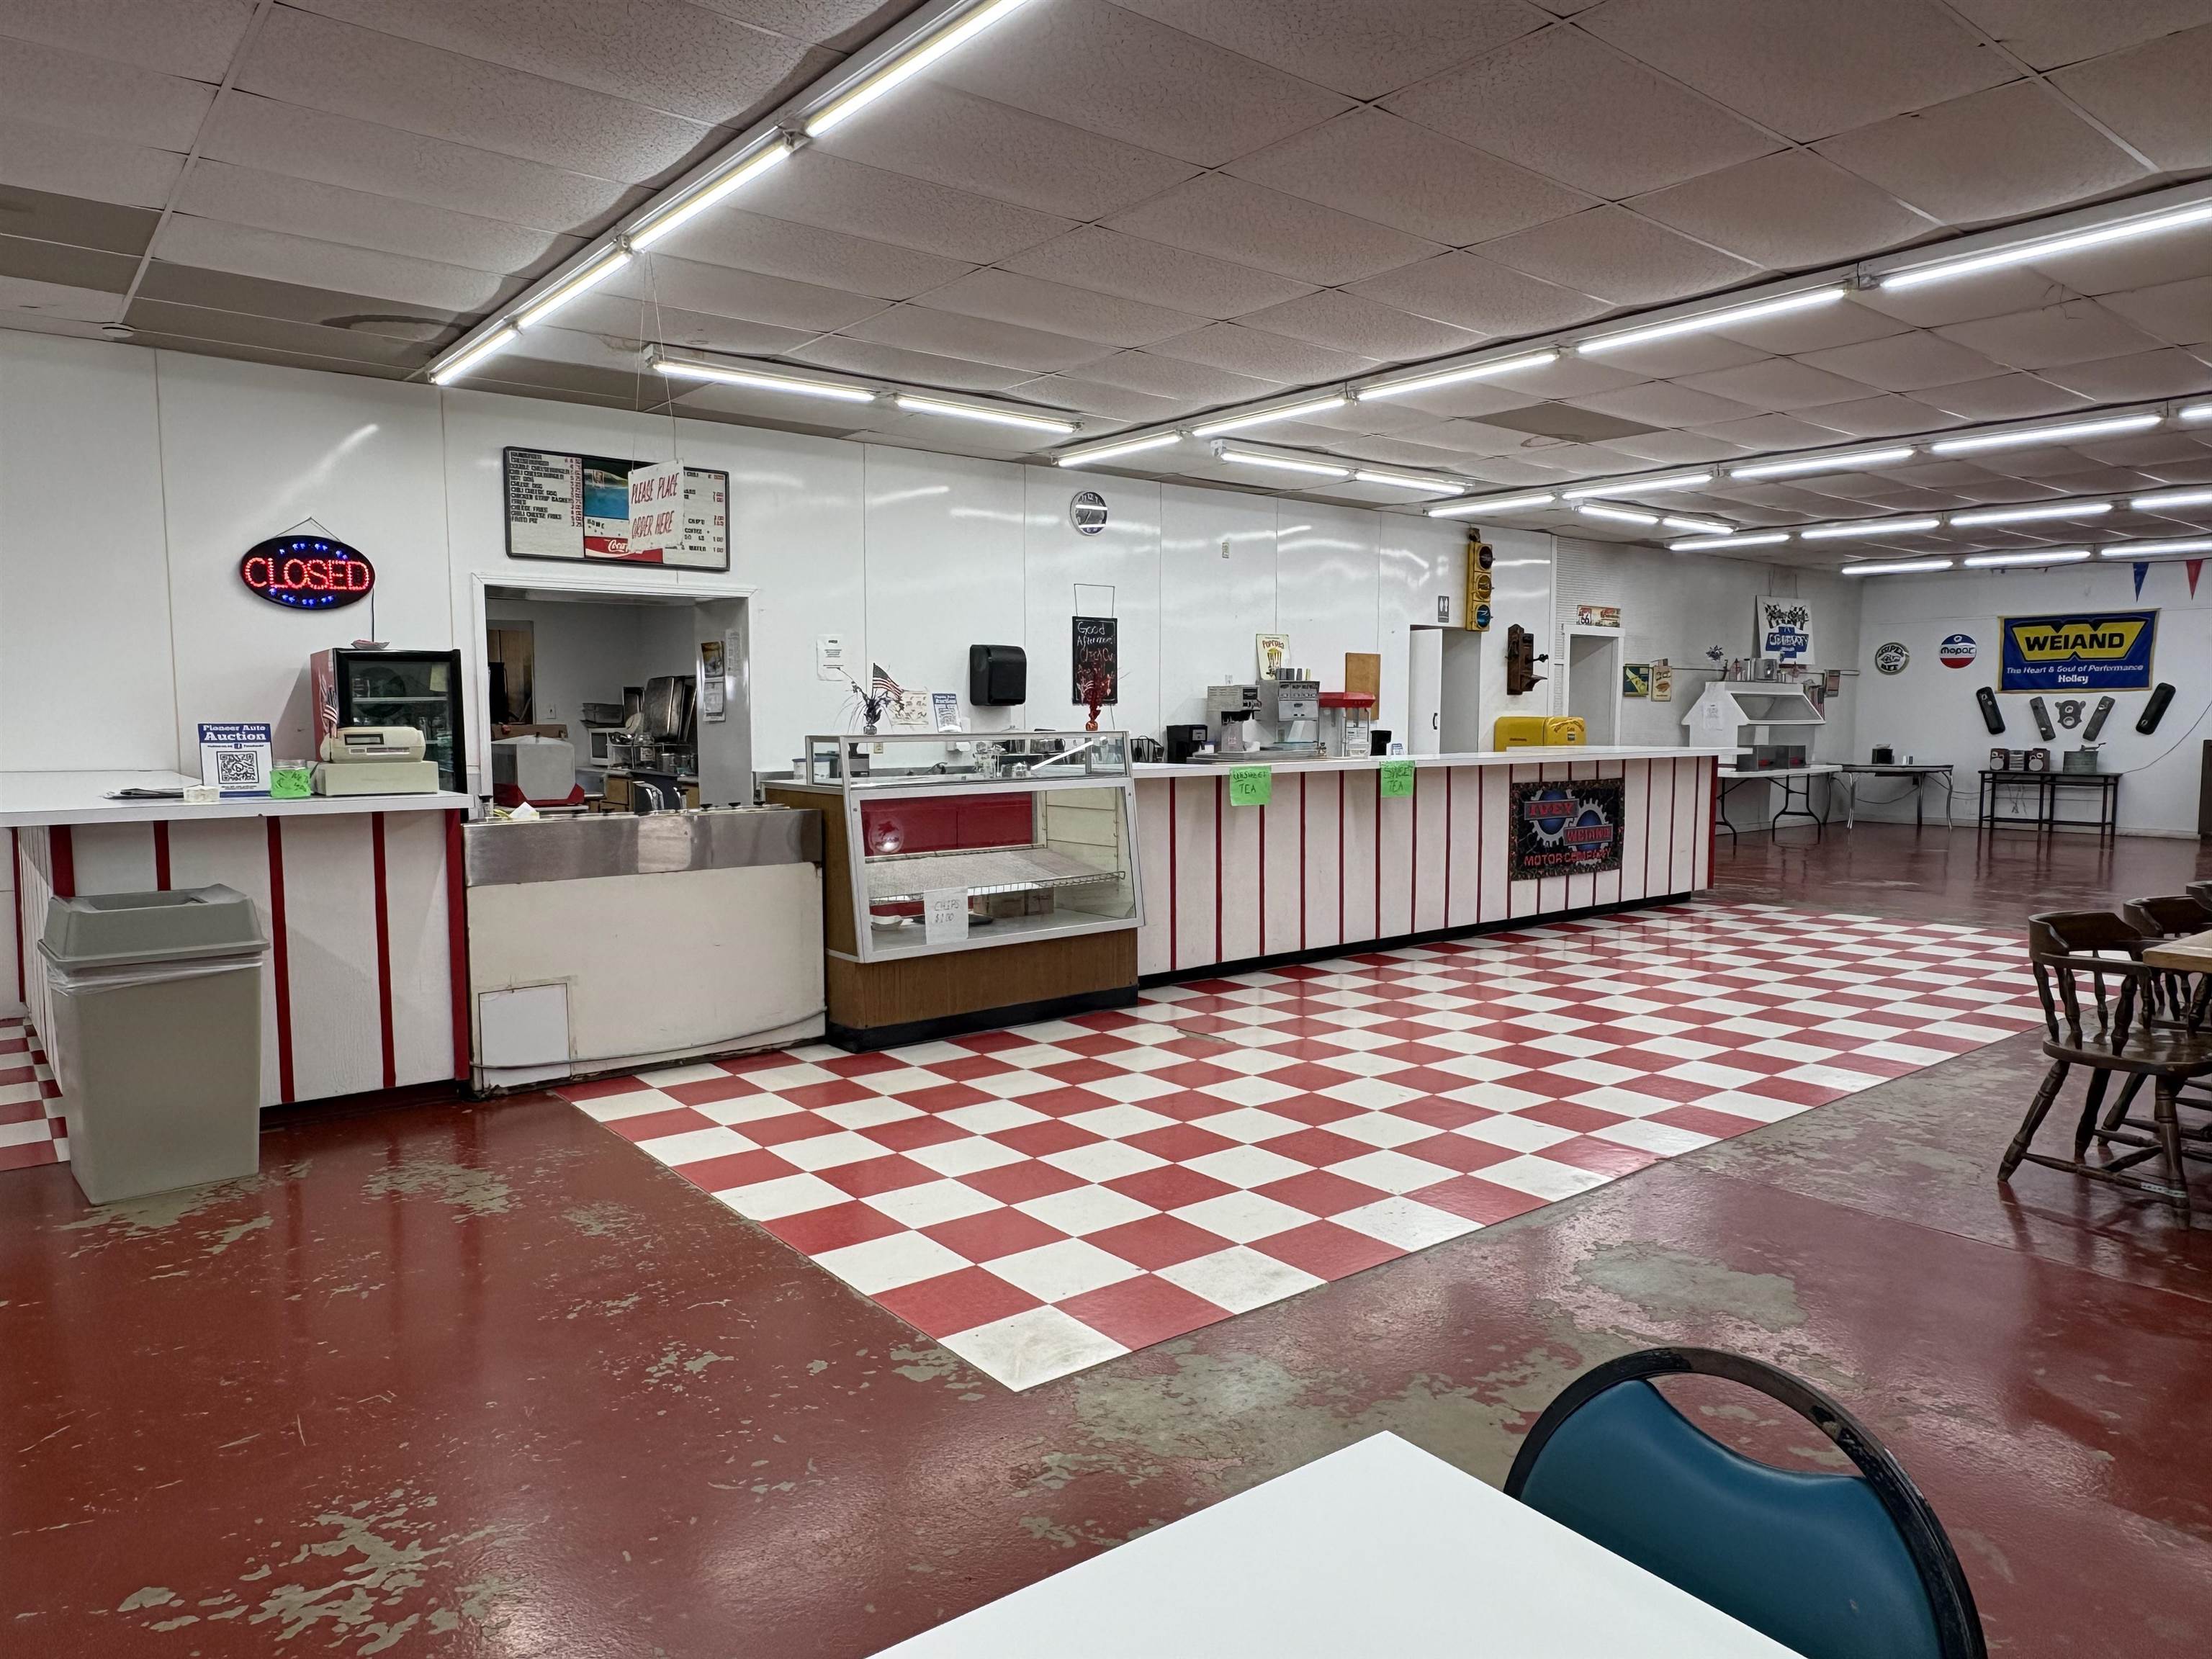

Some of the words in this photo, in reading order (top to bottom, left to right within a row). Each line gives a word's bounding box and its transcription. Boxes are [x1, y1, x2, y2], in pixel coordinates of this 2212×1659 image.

[631, 478, 655, 504] PLEASE
[657, 472, 680, 500] PLACE
[631, 515, 654, 539] ORDER
[655, 510, 675, 535] HERE
[245, 557, 370, 591] CLOSED
[1077, 621, 1105, 635] Good
[2025, 632, 2125, 652] WEIAND
[2058, 675, 2089, 684] Holley
[204, 731, 266, 741] Auction
[1238, 783, 1256, 793] TEA
[1524, 853, 1563, 866] MOTOR
[934, 899, 960, 912] CHIPS
